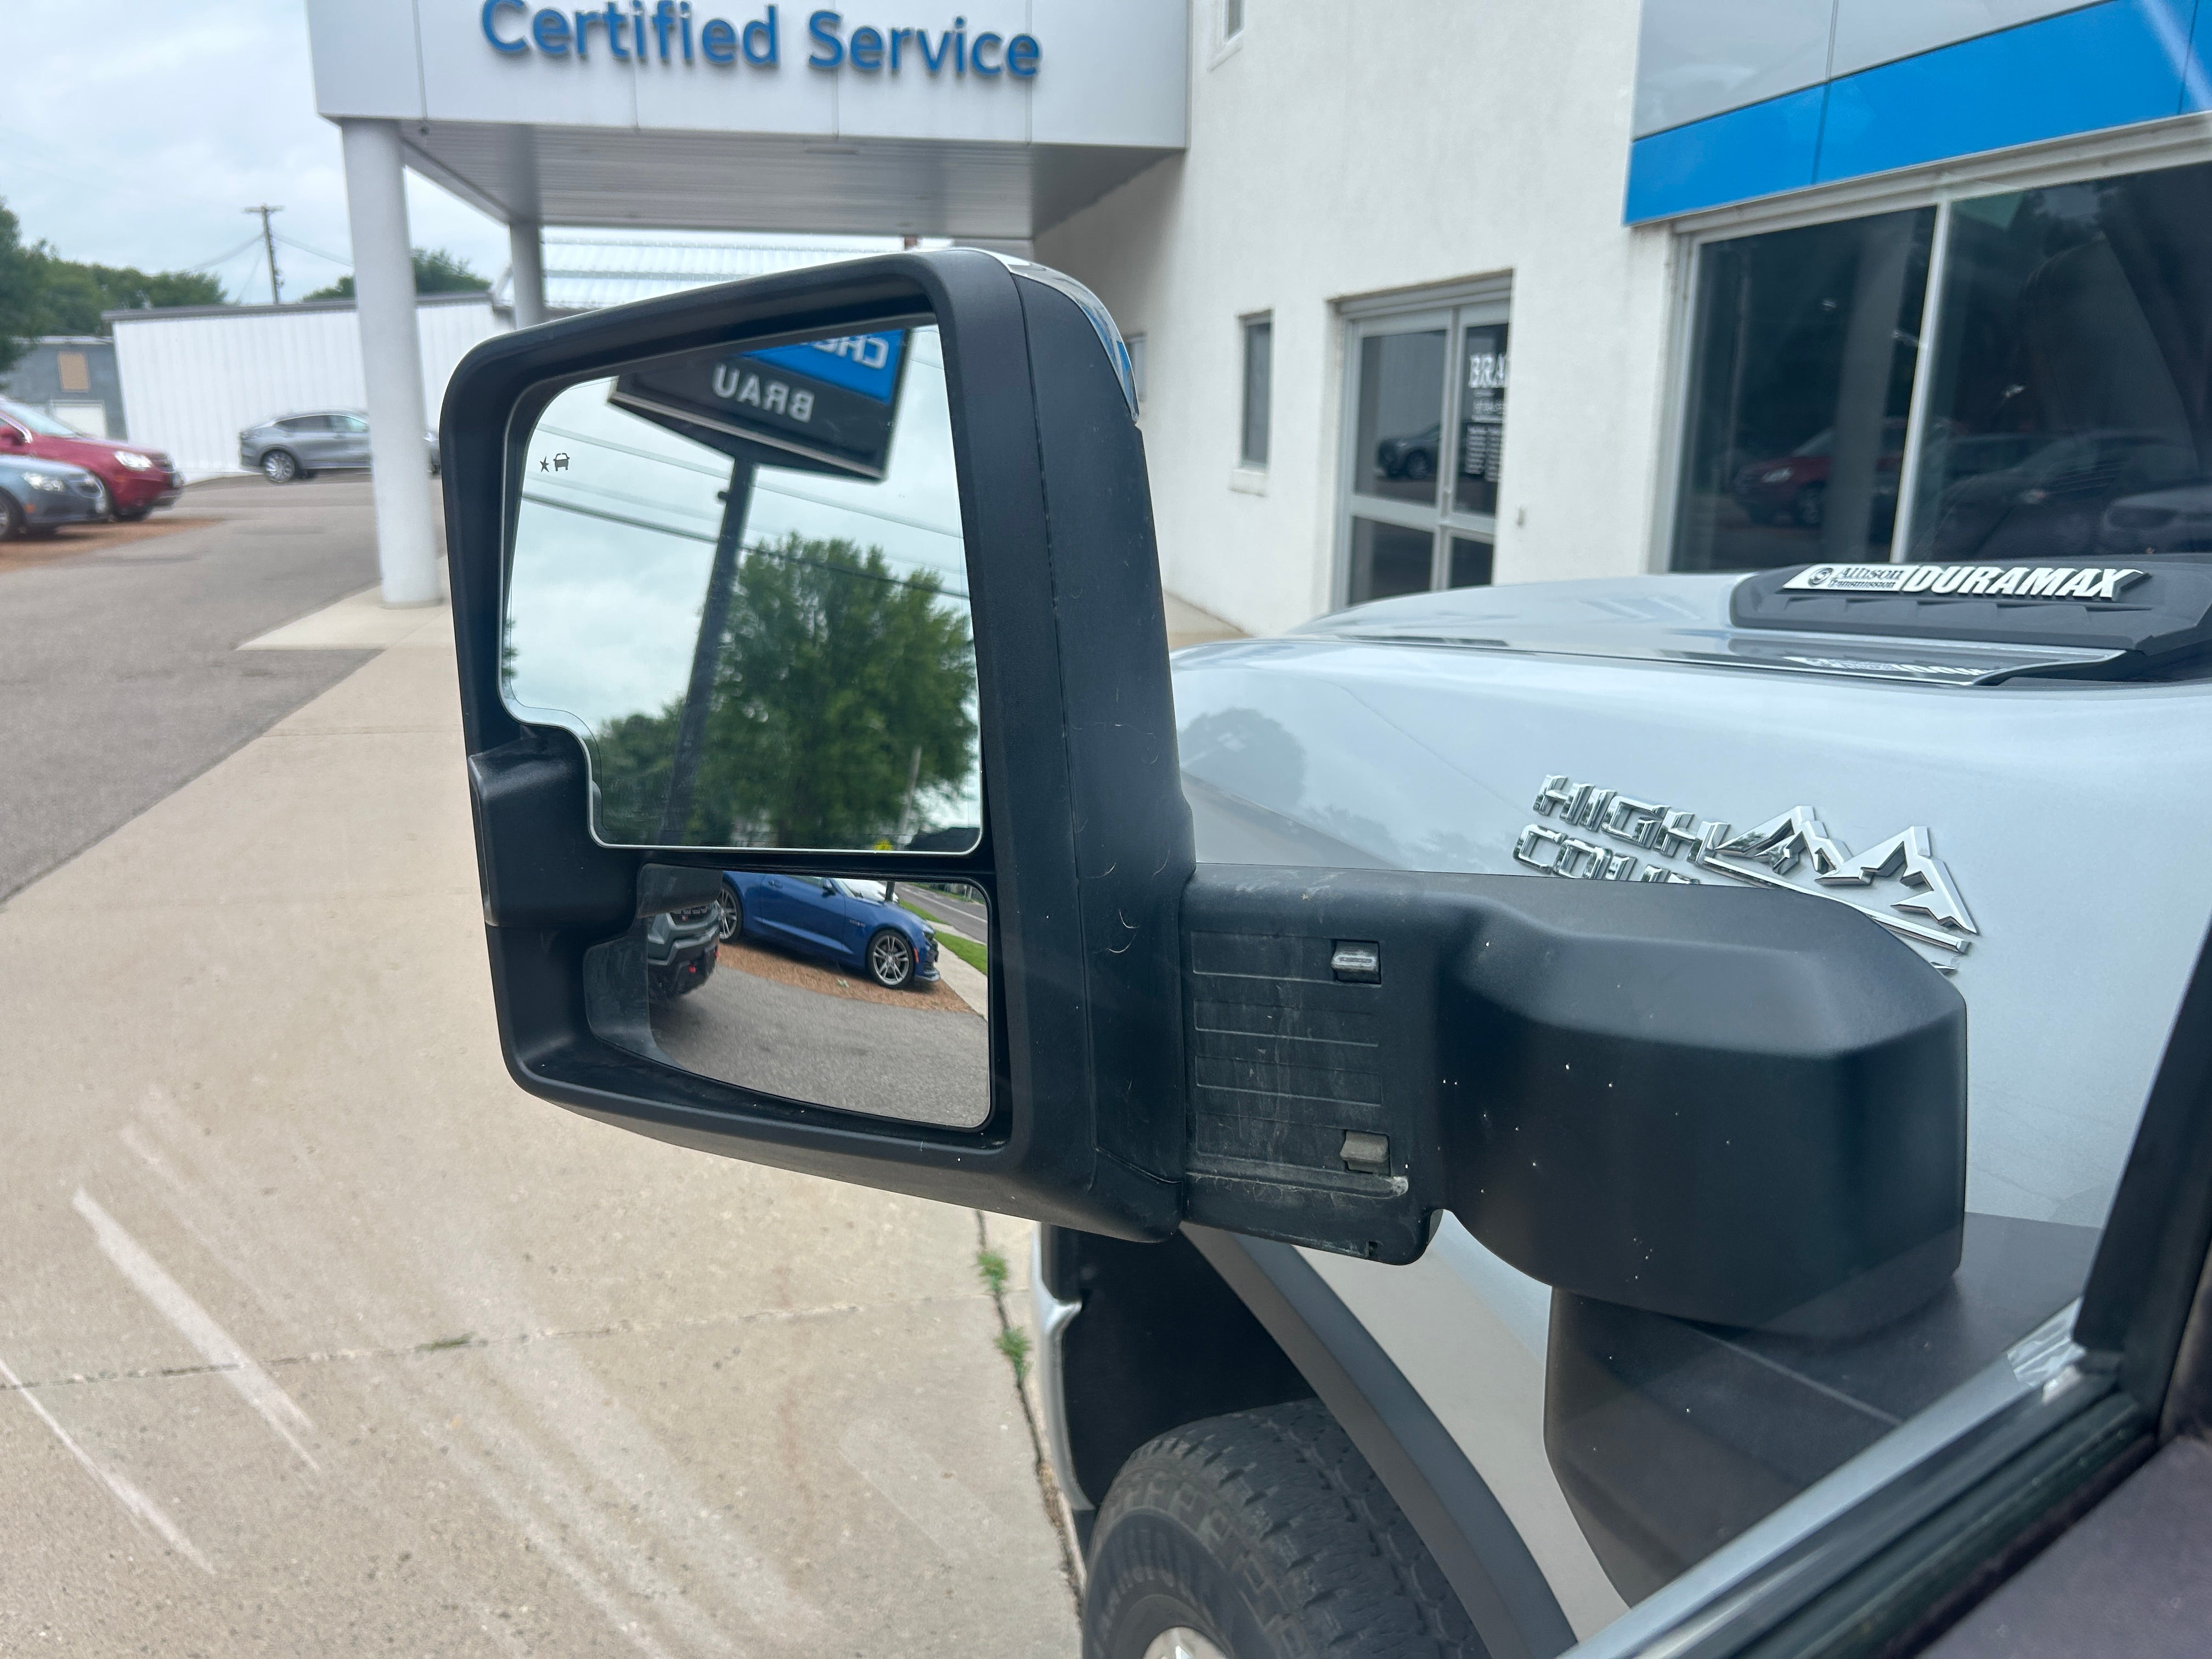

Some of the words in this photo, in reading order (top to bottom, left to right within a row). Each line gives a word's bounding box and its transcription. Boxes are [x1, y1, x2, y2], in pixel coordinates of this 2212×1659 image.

[481, 0, 778, 64] Certified
[808, 10, 1040, 76] Service
[1834, 567, 1904, 580] Allison
[1902, 566, 2145, 598] DURAMAX
[1533, 774, 1731, 865] HIGH
